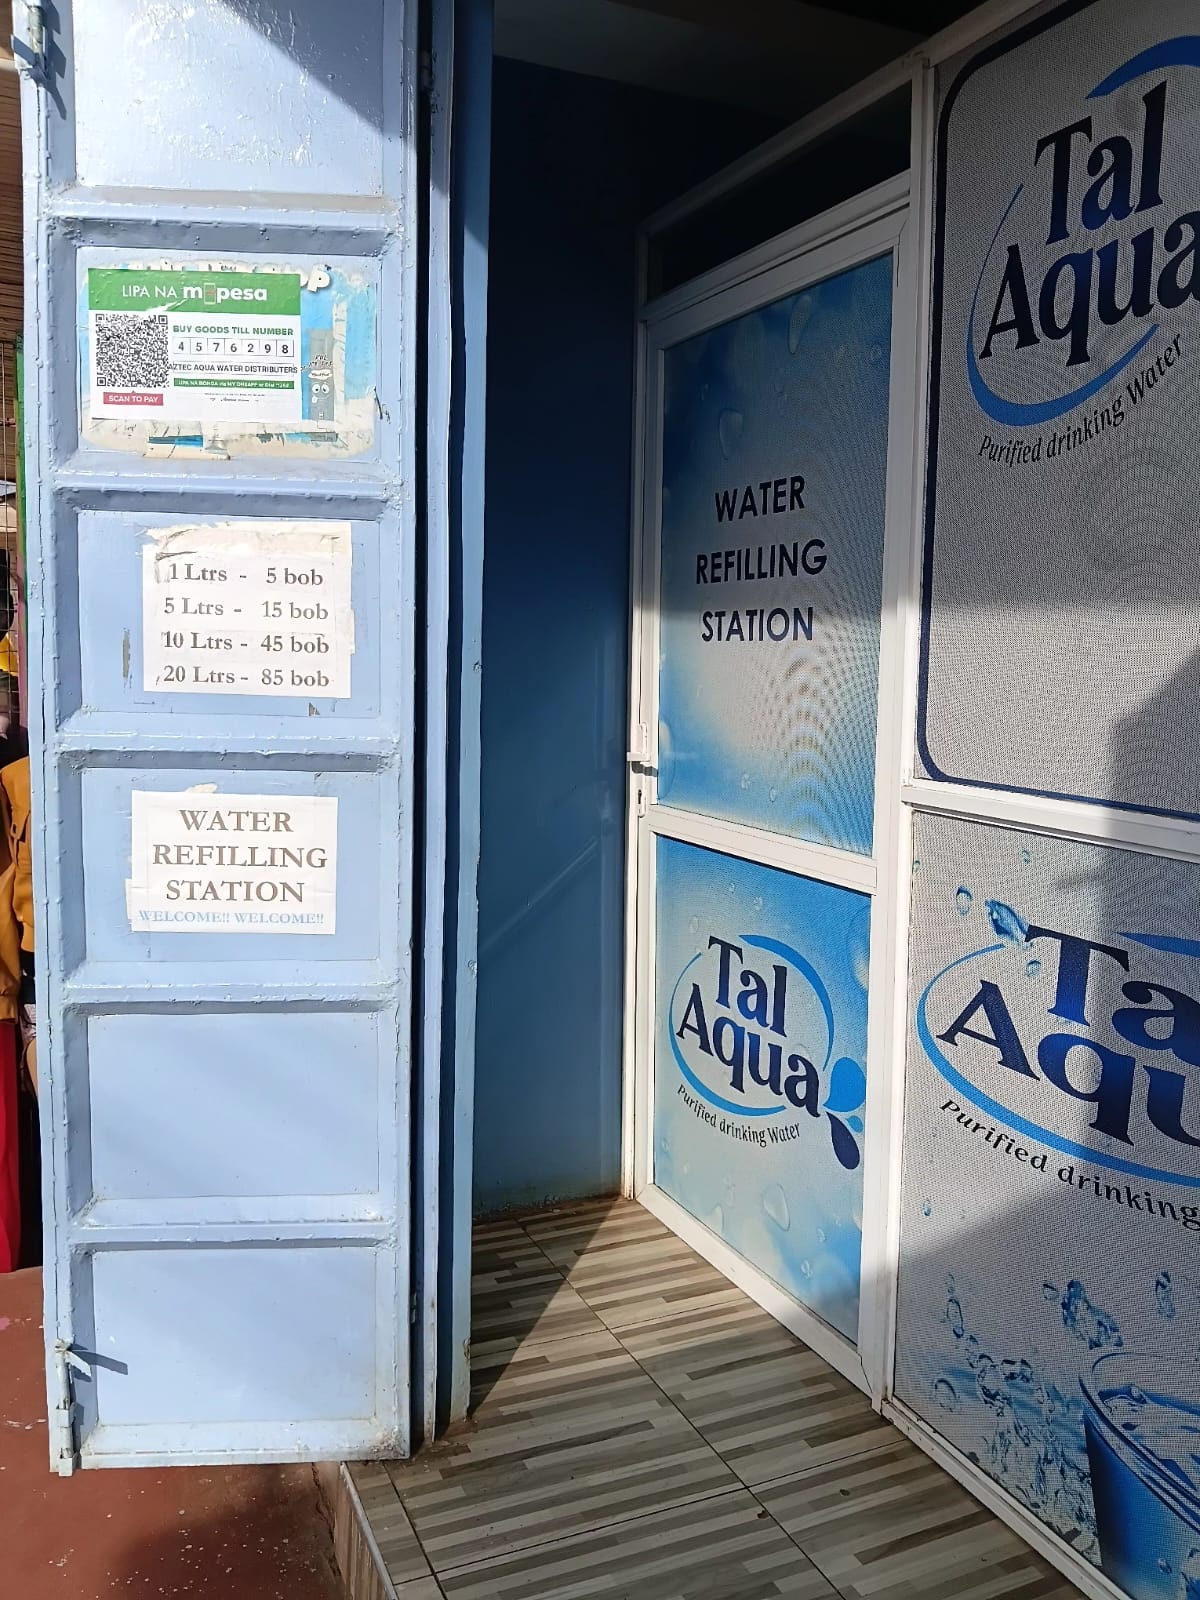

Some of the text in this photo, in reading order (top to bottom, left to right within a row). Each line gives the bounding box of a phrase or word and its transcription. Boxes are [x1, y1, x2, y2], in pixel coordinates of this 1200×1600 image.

[1034, 80, 1168, 246] Tal
[122, 285, 151, 298] LIPA
[154, 285, 178, 299] NA
[978, 210, 1200, 368] Aqua
[173, 325, 294, 336] BUY GOODS TILL NUMBER
[168, 363, 298, 374] AZTEC AQUA WATER DISTRIBUTERS
[108, 394, 130, 402] SCAN
[978, 332, 1184, 468] Purified drinking Water
[715, 475, 806, 523] WATER
[170, 563, 179, 580] 1
[184, 564, 228, 582] Ltrs
[266, 567, 277, 584] 5
[284, 567, 324, 586] bob
[696, 538, 827, 585] REFILLING
[164, 597, 175, 614] 5
[181, 597, 224, 615] Ltrs
[262, 600, 283, 618] 15
[289, 601, 329, 620] bob
[701, 606, 813, 642] STATION
[163, 631, 184, 649] 10
[190, 632, 233, 650] Ltrs
[260, 635, 284, 652] 45
[290, 636, 330, 654] bob
[163, 665, 186, 683] 20
[192, 666, 236, 684] Ltrs
[261, 668, 284, 686] 85
[291, 670, 330, 687] bob
[179, 809, 294, 833] WATER
[152, 844, 328, 869] REFILLING
[166, 879, 305, 903] STATION
[138, 910, 324, 925] WELCOME!! WELCOME!!
[707, 935, 788, 1038] Tal
[1024, 924, 1200, 1069] Ta
[675, 982, 821, 1118] Aqua
[936, 979, 1200, 1147] Aqu
[677, 1084, 800, 1148] Purified drinking Water
[939, 1098, 1200, 1233] Purified drinking
